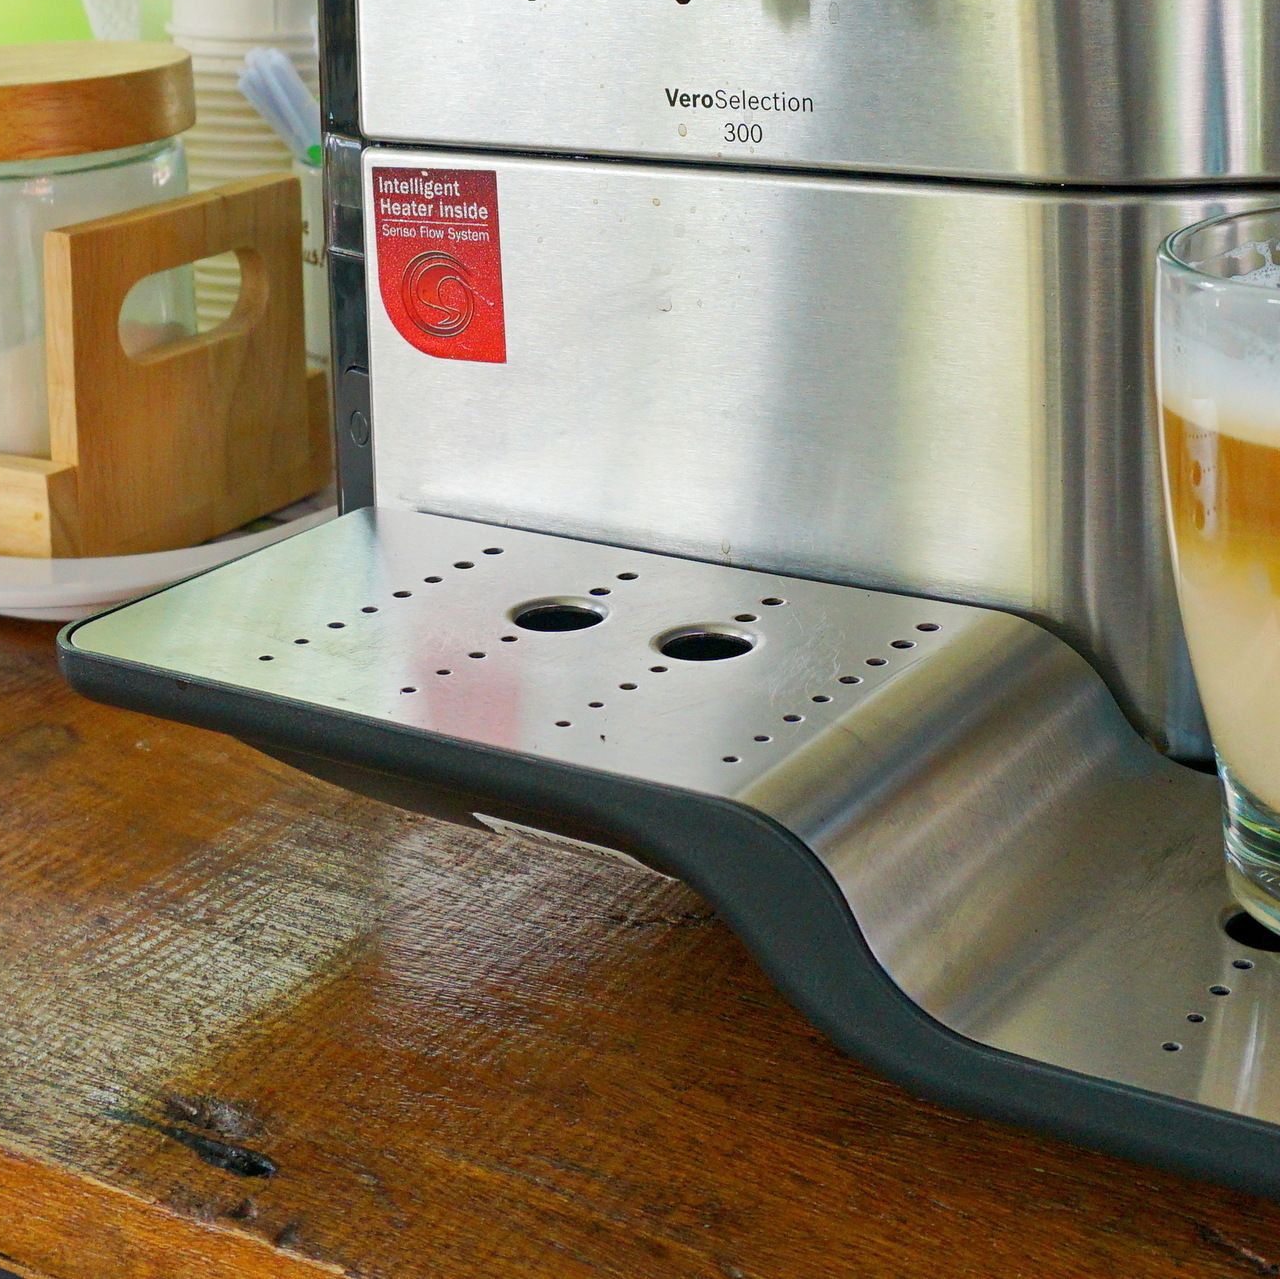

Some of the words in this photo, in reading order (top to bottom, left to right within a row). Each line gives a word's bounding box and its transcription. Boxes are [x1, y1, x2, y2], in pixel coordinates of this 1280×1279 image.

[664, 87, 814, 113] VeroSelection
[723, 122, 763, 144] 300
[379, 177, 461, 199] Intelligent
[380, 198, 434, 217] Heater
[440, 201, 489, 220] inside
[382, 223, 417, 238] Senso
[420, 226, 445, 239] Flow
[447, 227, 490, 243] System
